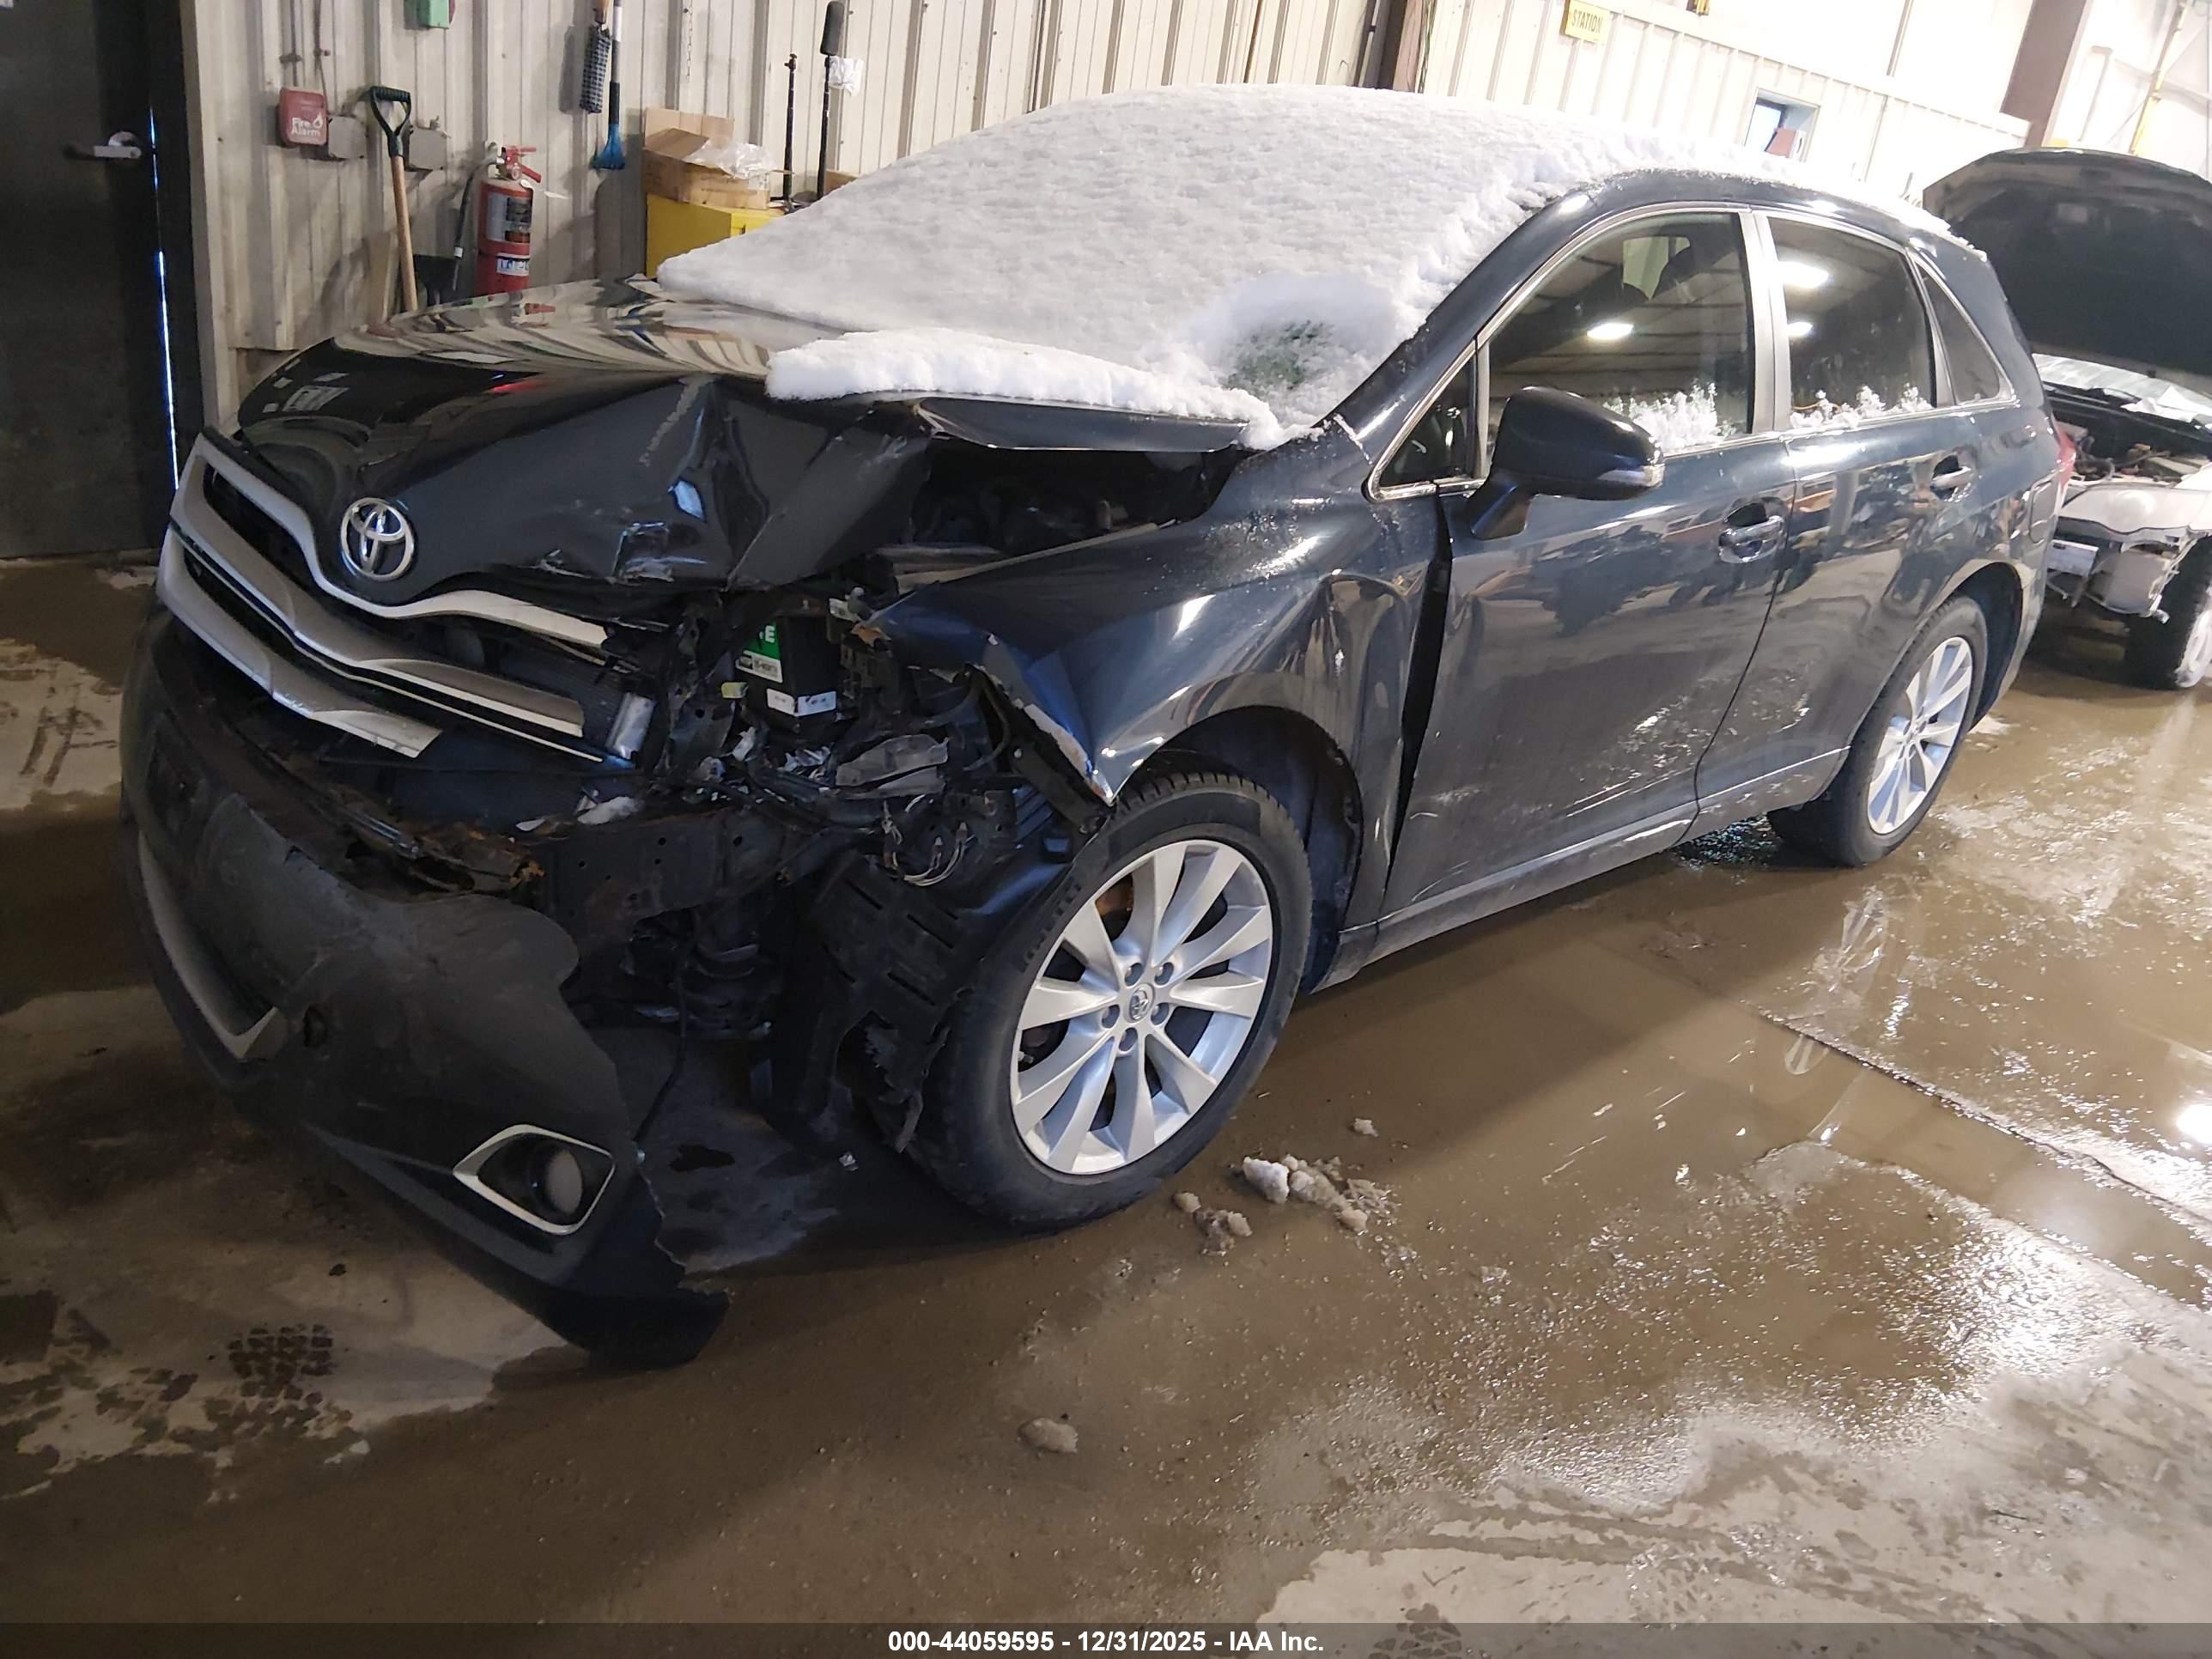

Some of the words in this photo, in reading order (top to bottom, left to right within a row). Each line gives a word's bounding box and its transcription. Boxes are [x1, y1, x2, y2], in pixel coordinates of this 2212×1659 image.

[1571, 9, 1603, 33] STATION
[292, 117, 311, 128] Fire
[291, 125, 320, 137] Alarm
